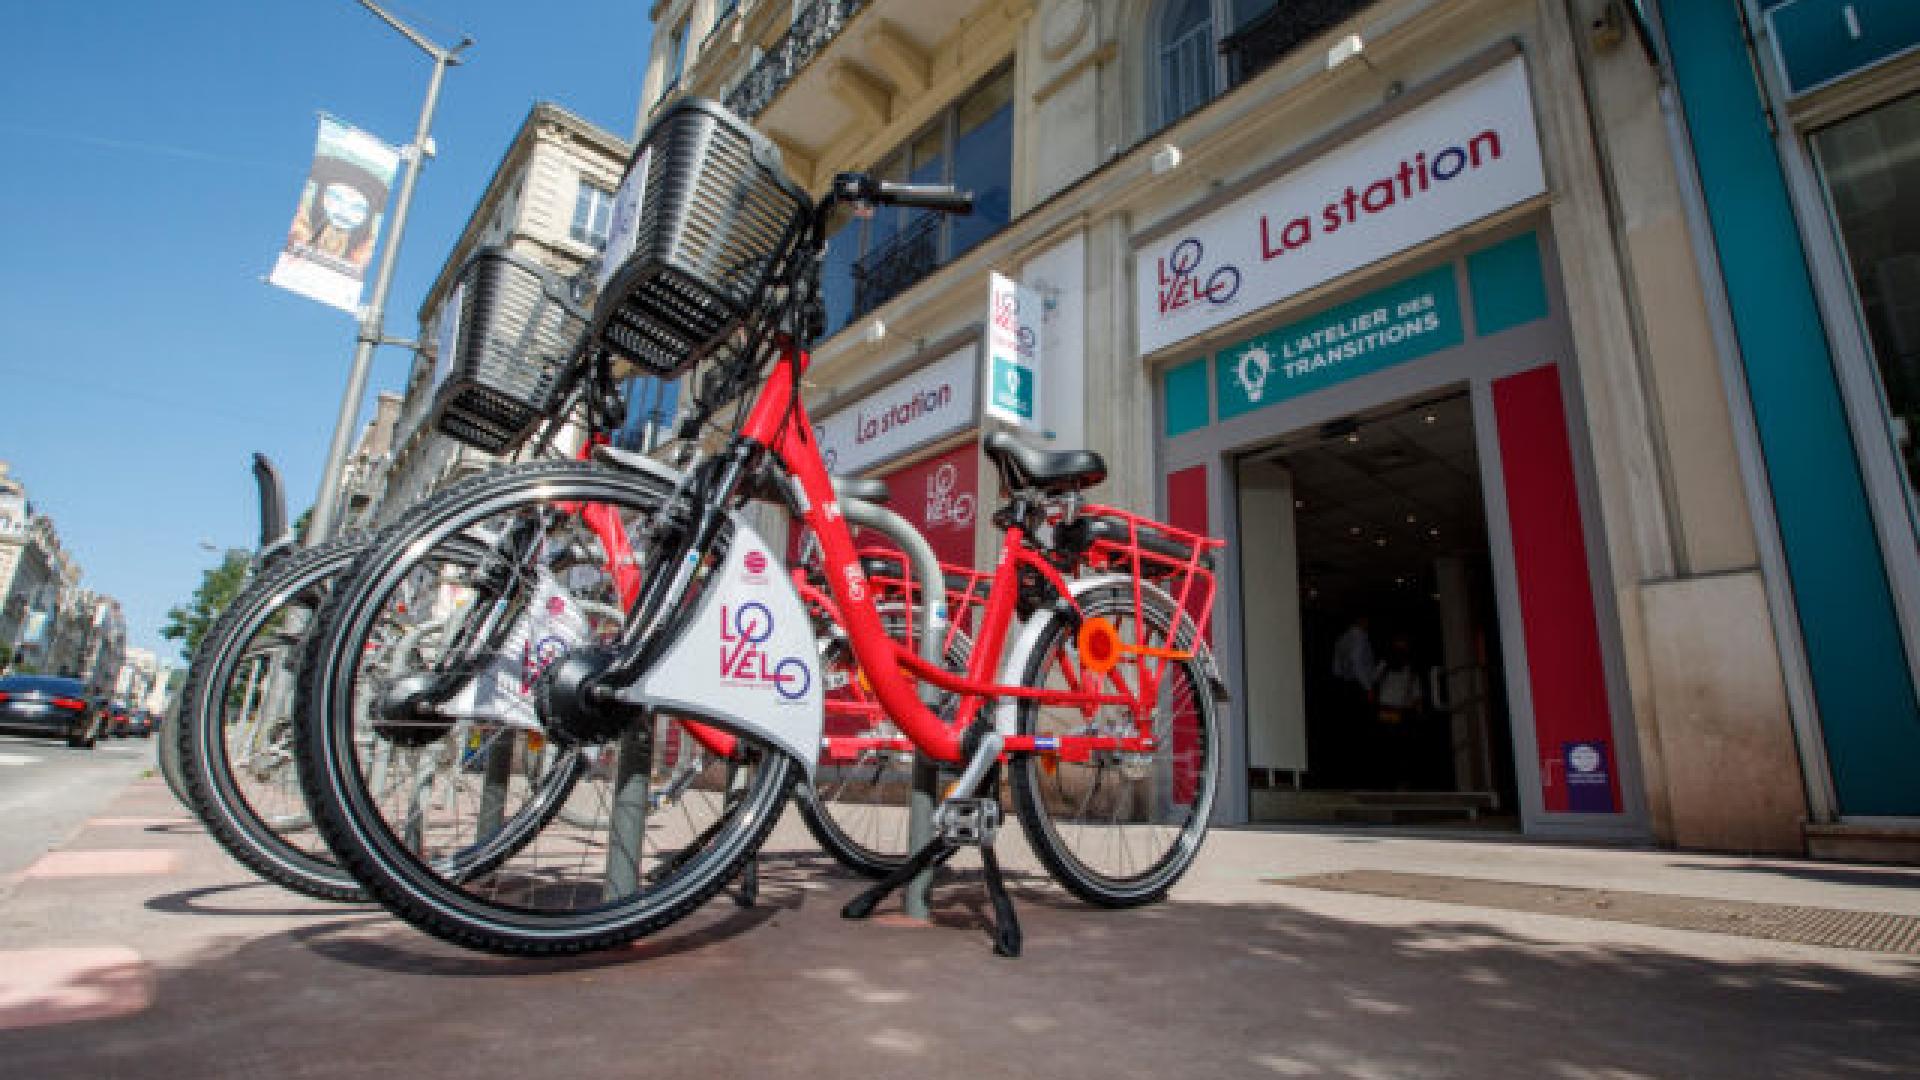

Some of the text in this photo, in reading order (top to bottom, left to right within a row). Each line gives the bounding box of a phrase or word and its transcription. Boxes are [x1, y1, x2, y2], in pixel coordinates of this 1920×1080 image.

[1260, 128, 1502, 262] La station
[1283, 294, 1435, 358] L'ATELIER DES
[1283, 311, 1440, 378] TRANSITIONS
[855, 406, 878, 445] La
[881, 383, 953, 433] station
[720, 602, 773, 642] LO
